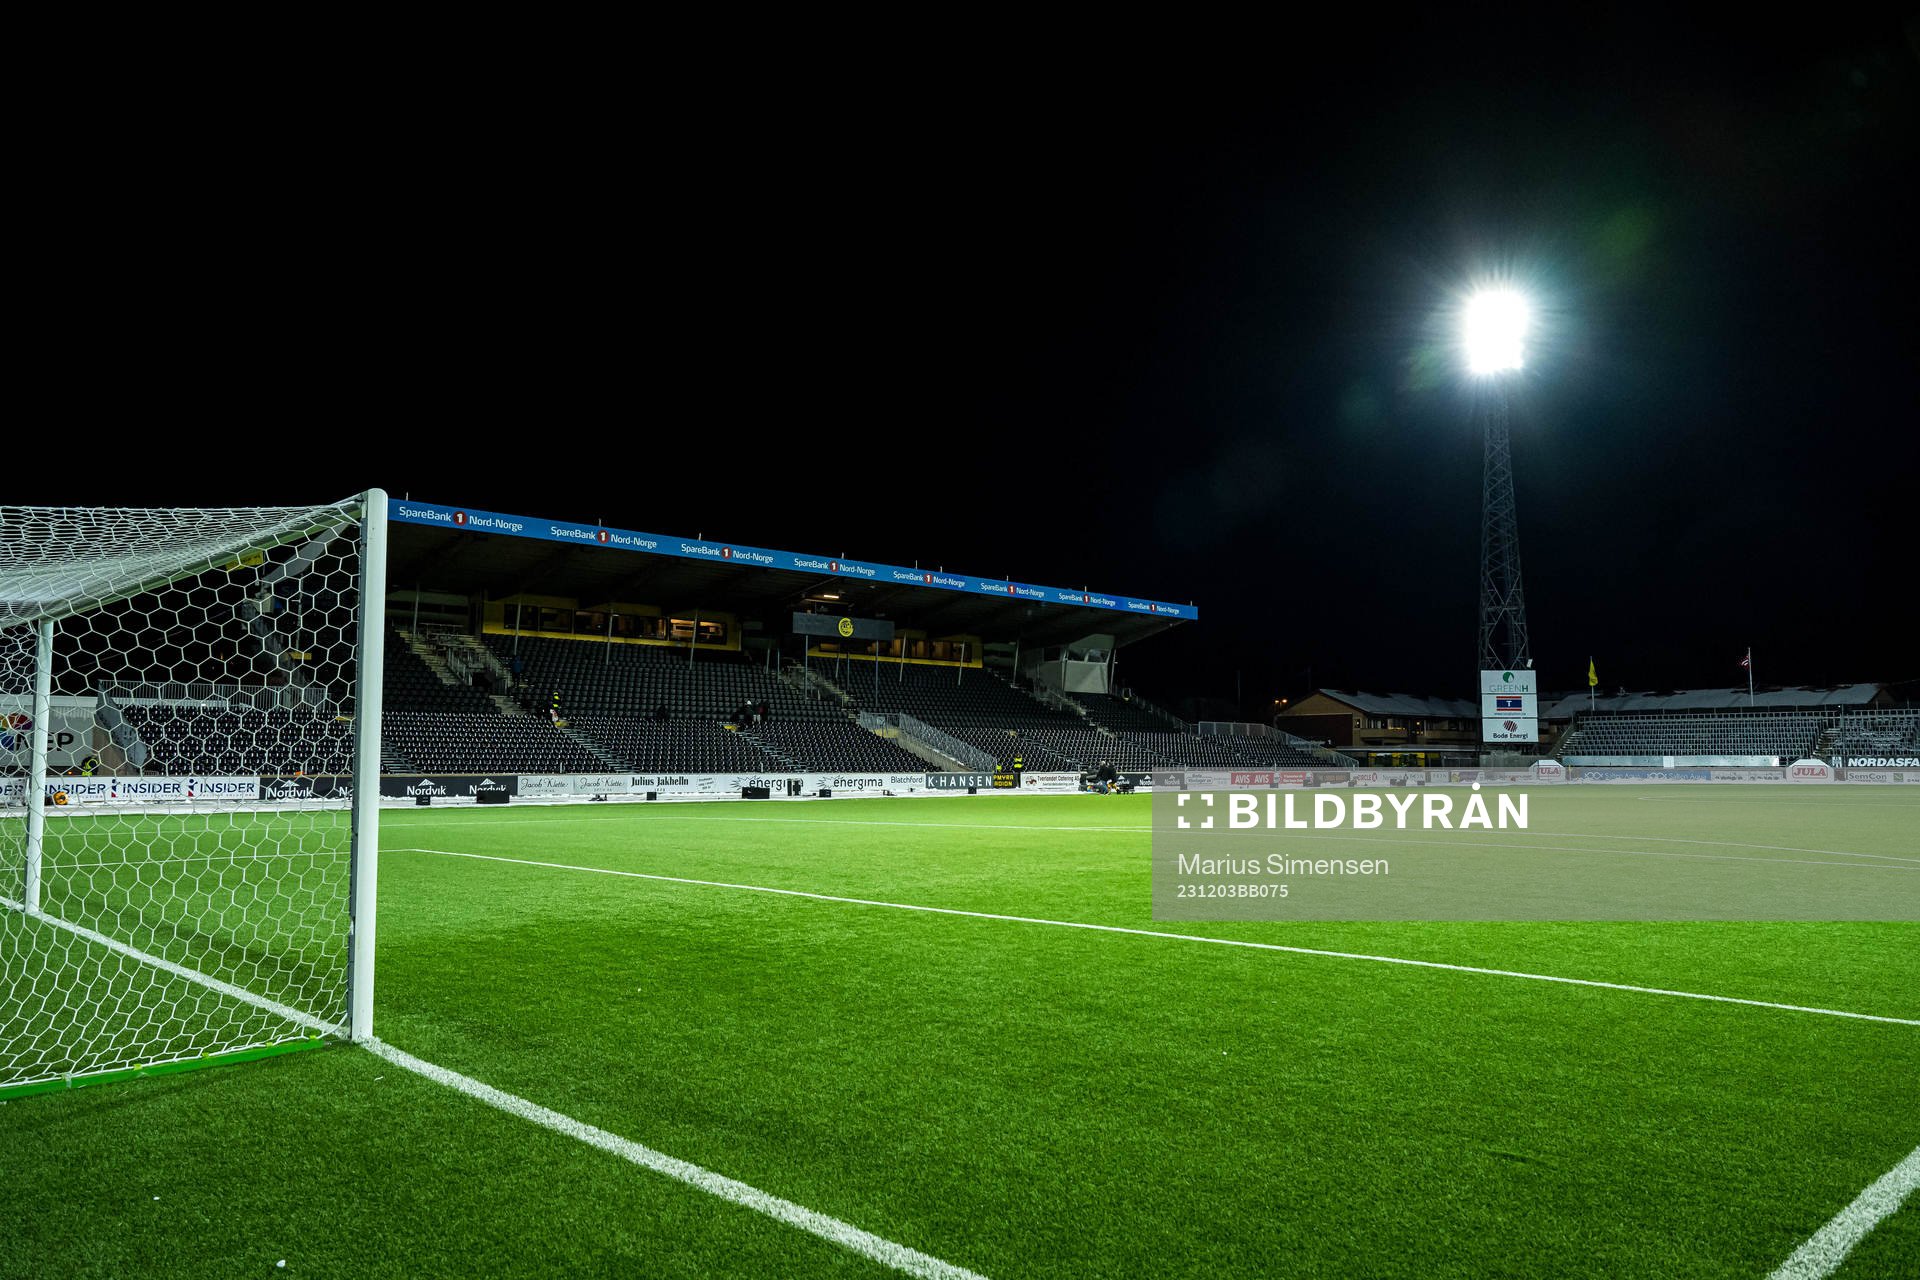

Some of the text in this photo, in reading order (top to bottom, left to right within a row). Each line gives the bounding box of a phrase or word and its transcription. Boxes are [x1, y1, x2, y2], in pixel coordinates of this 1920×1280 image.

[399, 506, 451, 522] SpareBank
[469, 515, 523, 532] Nord-Norge
[550, 526, 596, 541] SpareBank
[610, 534, 657, 549] Nord-Norge
[681, 543, 720, 557] SpareBank
[733, 550, 773, 564] Nord-Norge
[794, 558, 829, 570] SpareBank
[839, 563, 875, 576] Nord-Norge
[893, 570, 924, 582] SpareBank
[933, 576, 966, 588] Nord-Norge
[980, 583, 1008, 593] SpareBank
[1016, 587, 1044, 598] Nord-Norge
[1488, 684, 1529, 693] GREENH
[1848, 758, 1920, 768] NORDASFA
[1793, 767, 1826, 777] JULA
[1849, 772, 1887, 780] SemCon
[521, 777, 542, 790] Jacob
[631, 776, 655, 787] Julius
[656, 776, 689, 787] Jakhelln
[749, 776, 804, 791] energia
[833, 776, 883, 790] energima
[890, 775, 923, 784] Blatchford
[1234, 773, 1250, 784] AVIS
[1253, 773, 1270, 784] AVIS
[122, 783, 181, 795] INSIDER
[200, 782, 255, 794] INSIDER
[268, 787, 313, 798] Nordvik
[406, 785, 447, 796] Nordvik
